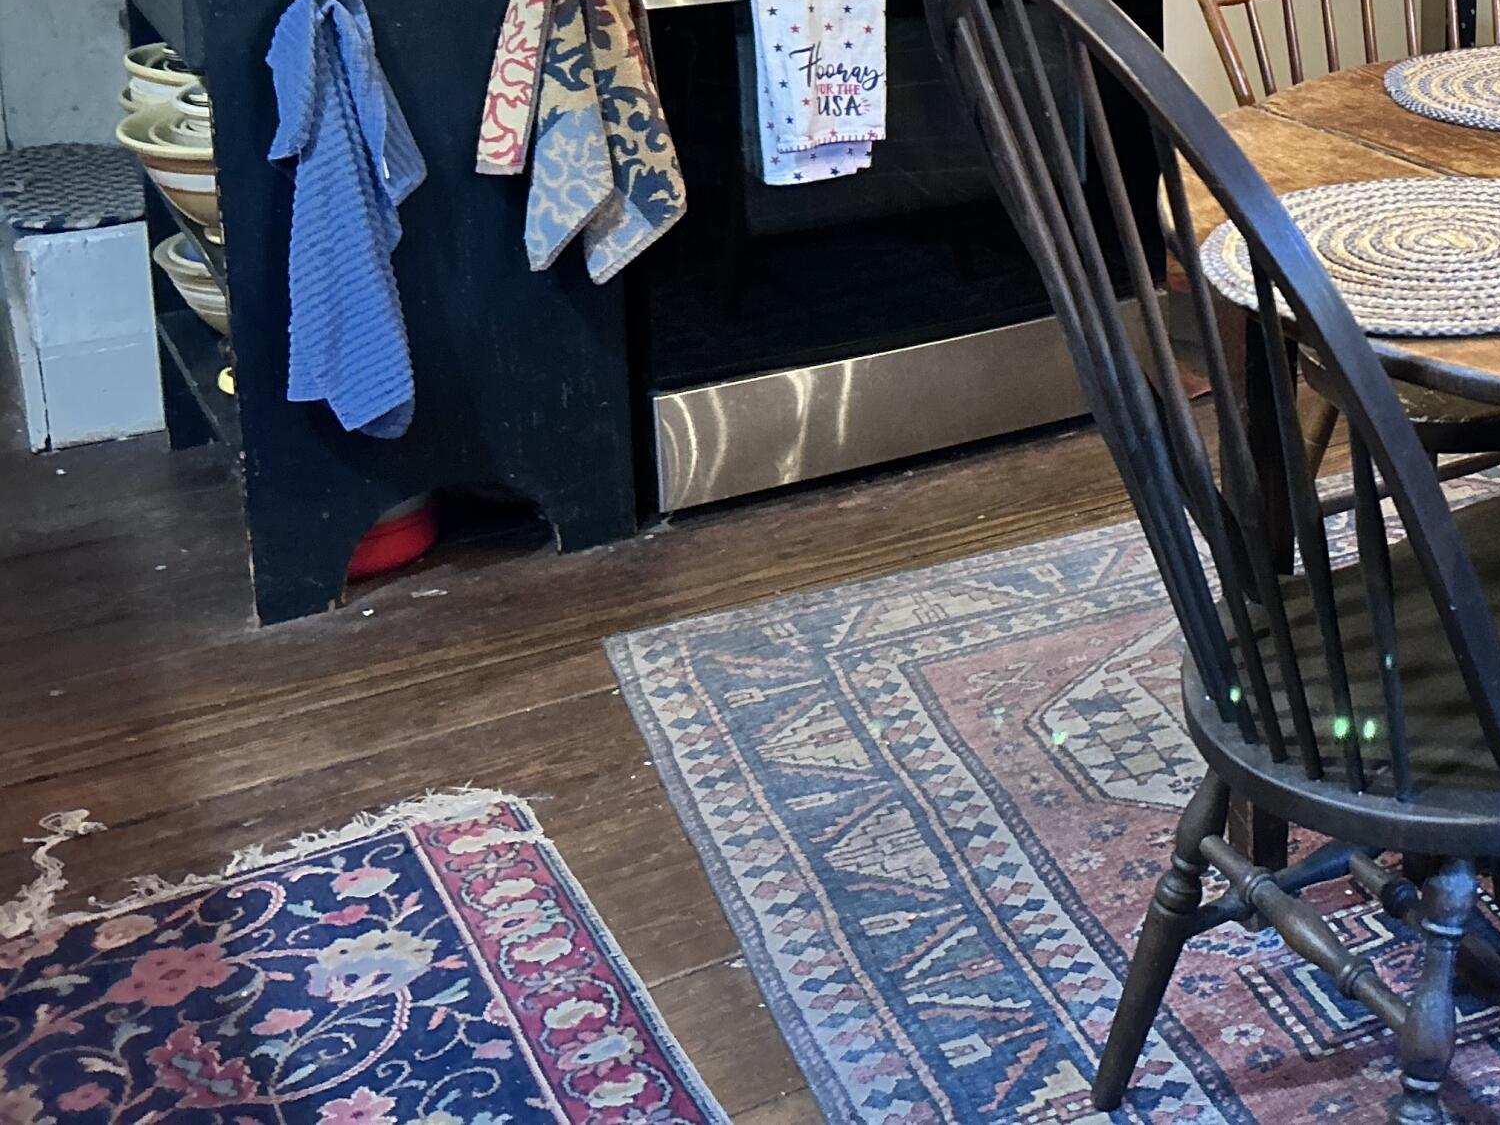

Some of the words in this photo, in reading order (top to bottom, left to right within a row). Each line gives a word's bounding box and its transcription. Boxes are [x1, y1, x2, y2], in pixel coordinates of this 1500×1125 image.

[788, 41, 884, 91] Hooray
[836, 83, 861, 96] THE
[816, 95, 863, 117] USA
